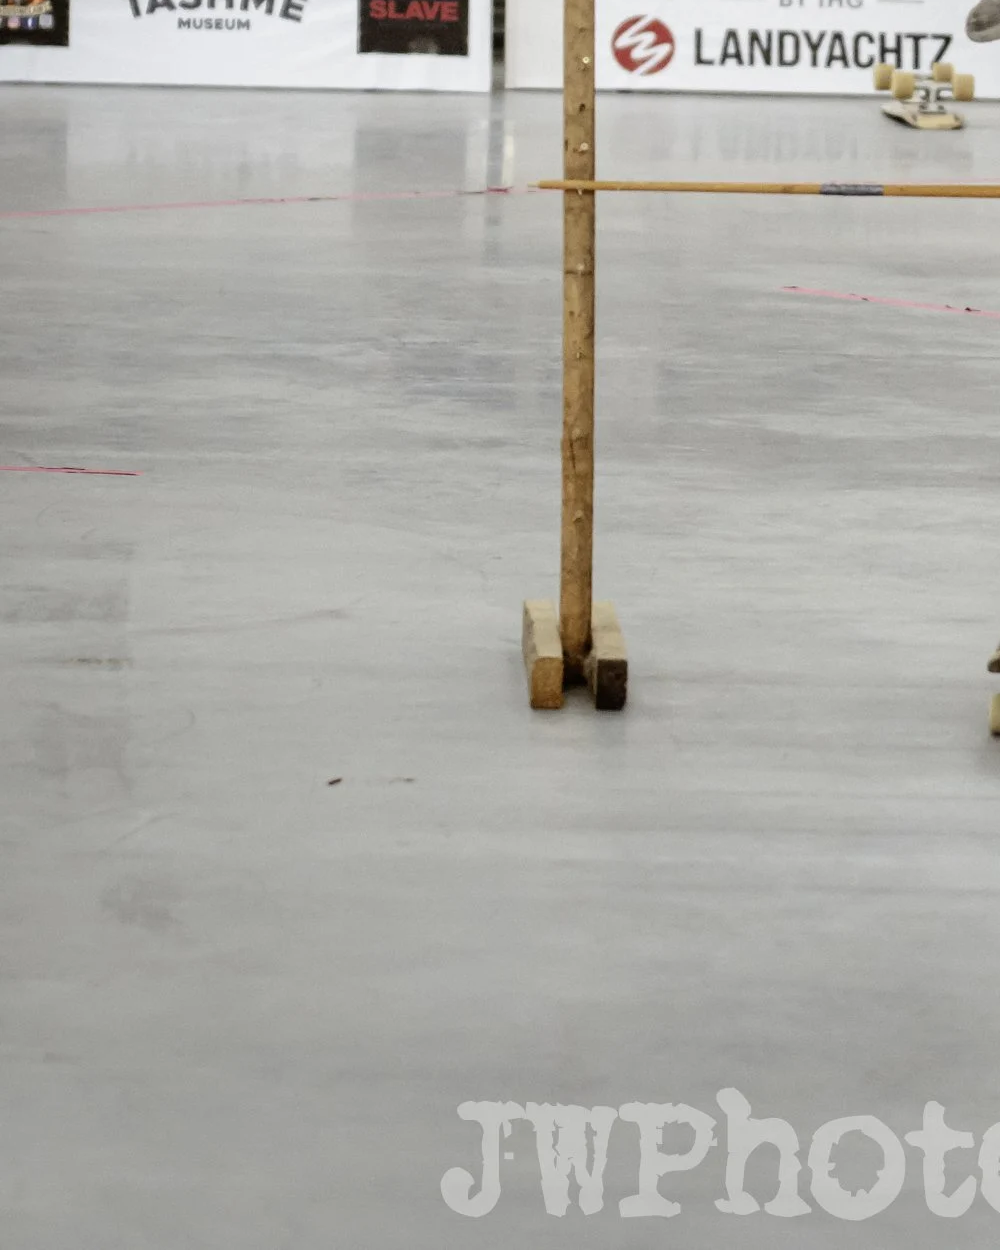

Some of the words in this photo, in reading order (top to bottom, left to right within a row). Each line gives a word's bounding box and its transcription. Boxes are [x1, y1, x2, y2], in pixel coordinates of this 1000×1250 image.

[368, 0, 460, 22] SLAVE
[177, 17, 251, 31] MUSEUM
[693, 28, 953, 70] LANDYACHTZ
